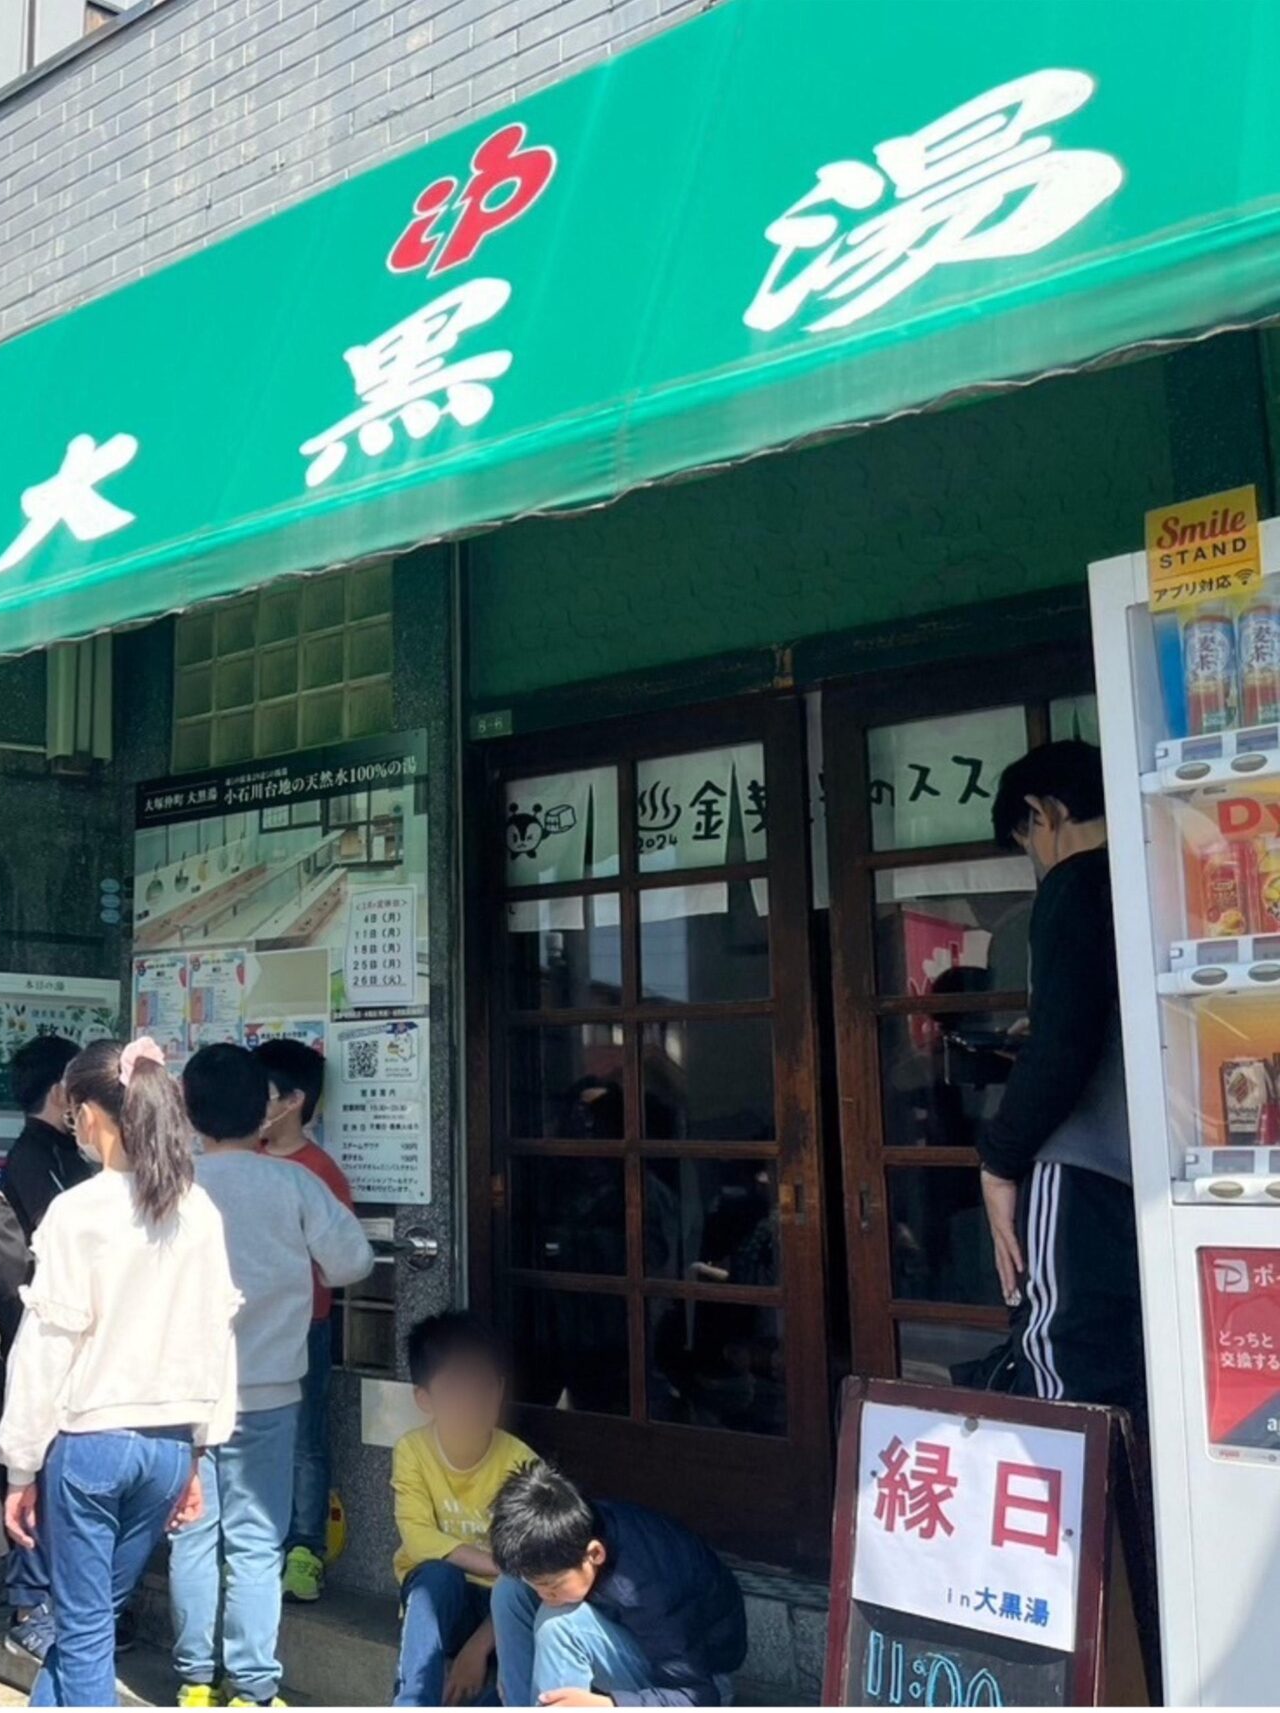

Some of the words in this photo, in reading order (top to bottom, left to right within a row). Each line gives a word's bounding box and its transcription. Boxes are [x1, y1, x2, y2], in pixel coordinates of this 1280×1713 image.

[1156, 508, 1247, 549] Smile
[1159, 537, 1247, 569] STAND
[1154, 574, 1232, 602] アプリ対応
[223, 755, 417, 805] 小石川台地の天然水100%の湯
[1220, 1351, 1280, 1370] 交換する
[874, 1435, 1063, 1557] 縁日
